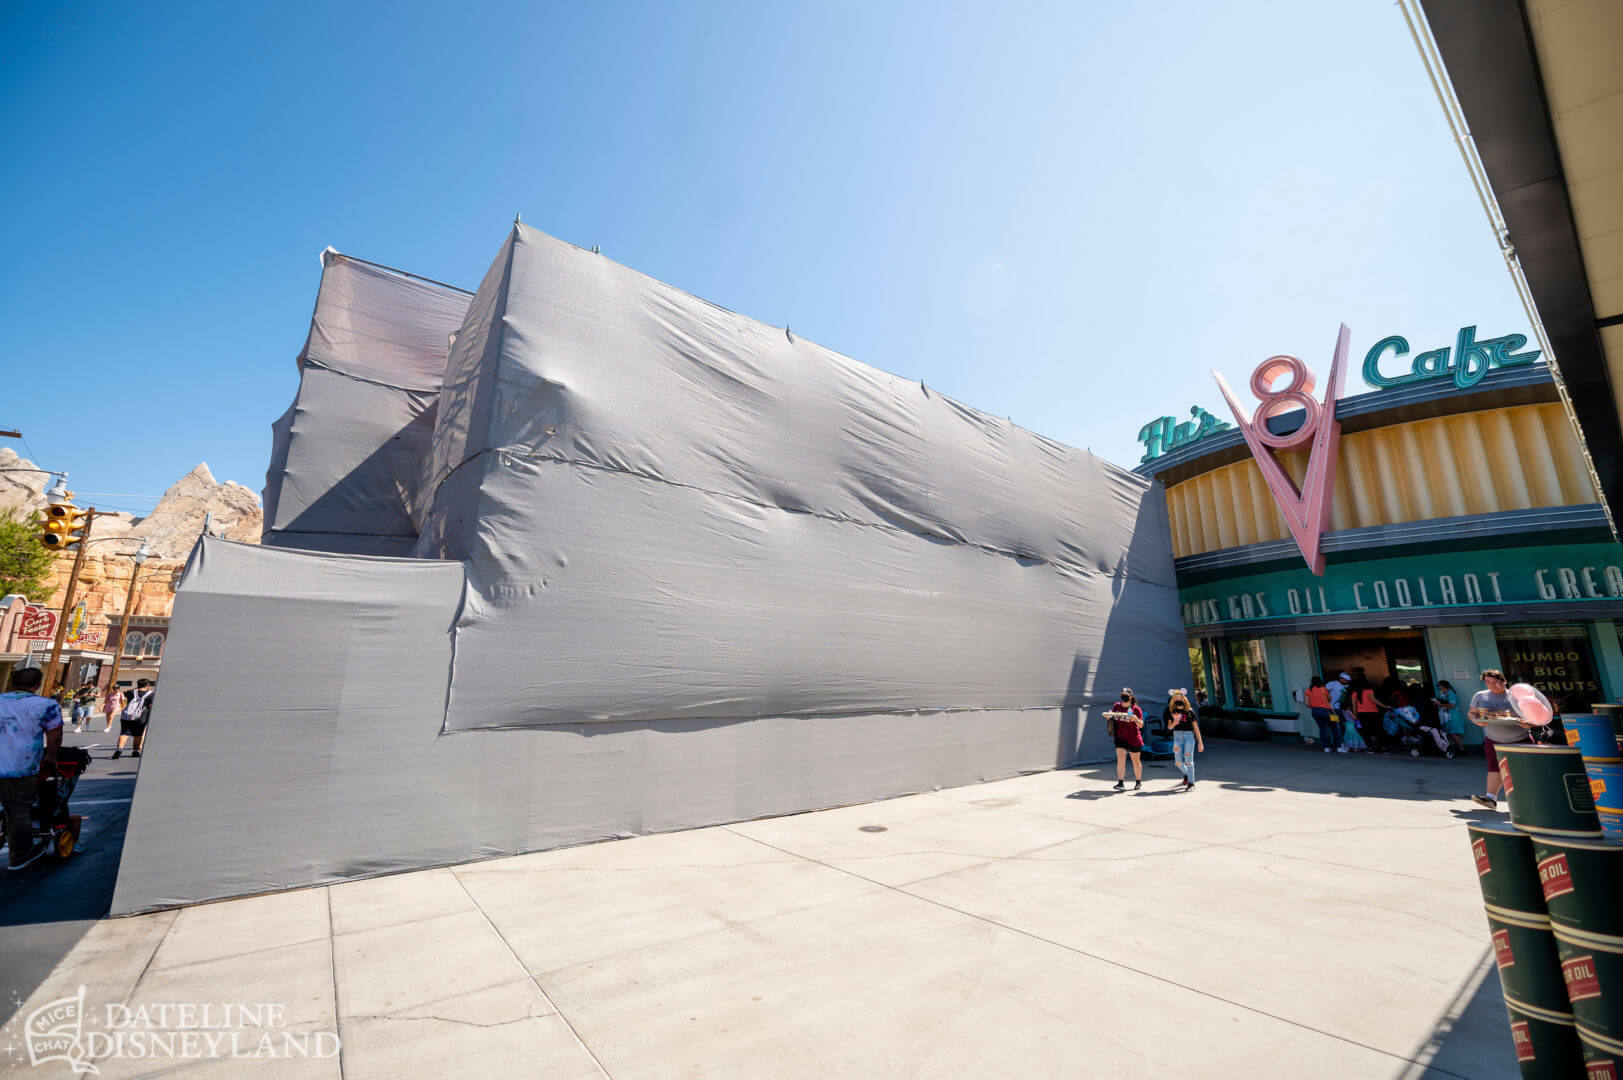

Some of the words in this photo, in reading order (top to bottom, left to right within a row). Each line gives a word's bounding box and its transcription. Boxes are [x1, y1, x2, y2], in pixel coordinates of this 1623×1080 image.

[1362, 325, 1542, 390] Cafe
[1228, 591, 1269, 620] GAS
[1287, 585, 1331, 615] OIL
[1353, 572, 1503, 610] COOLANT
[1513, 652, 1580, 662] JUMBO
[1533, 666, 1567, 677] BIG
[1534, 680, 1598, 692] GNUTS
[1548, 862, 1568, 879] OIL
[1495, 937, 1509, 952] OIL
[1574, 964, 1595, 981] OIL
[1515, 1030, 1530, 1044] OIL
